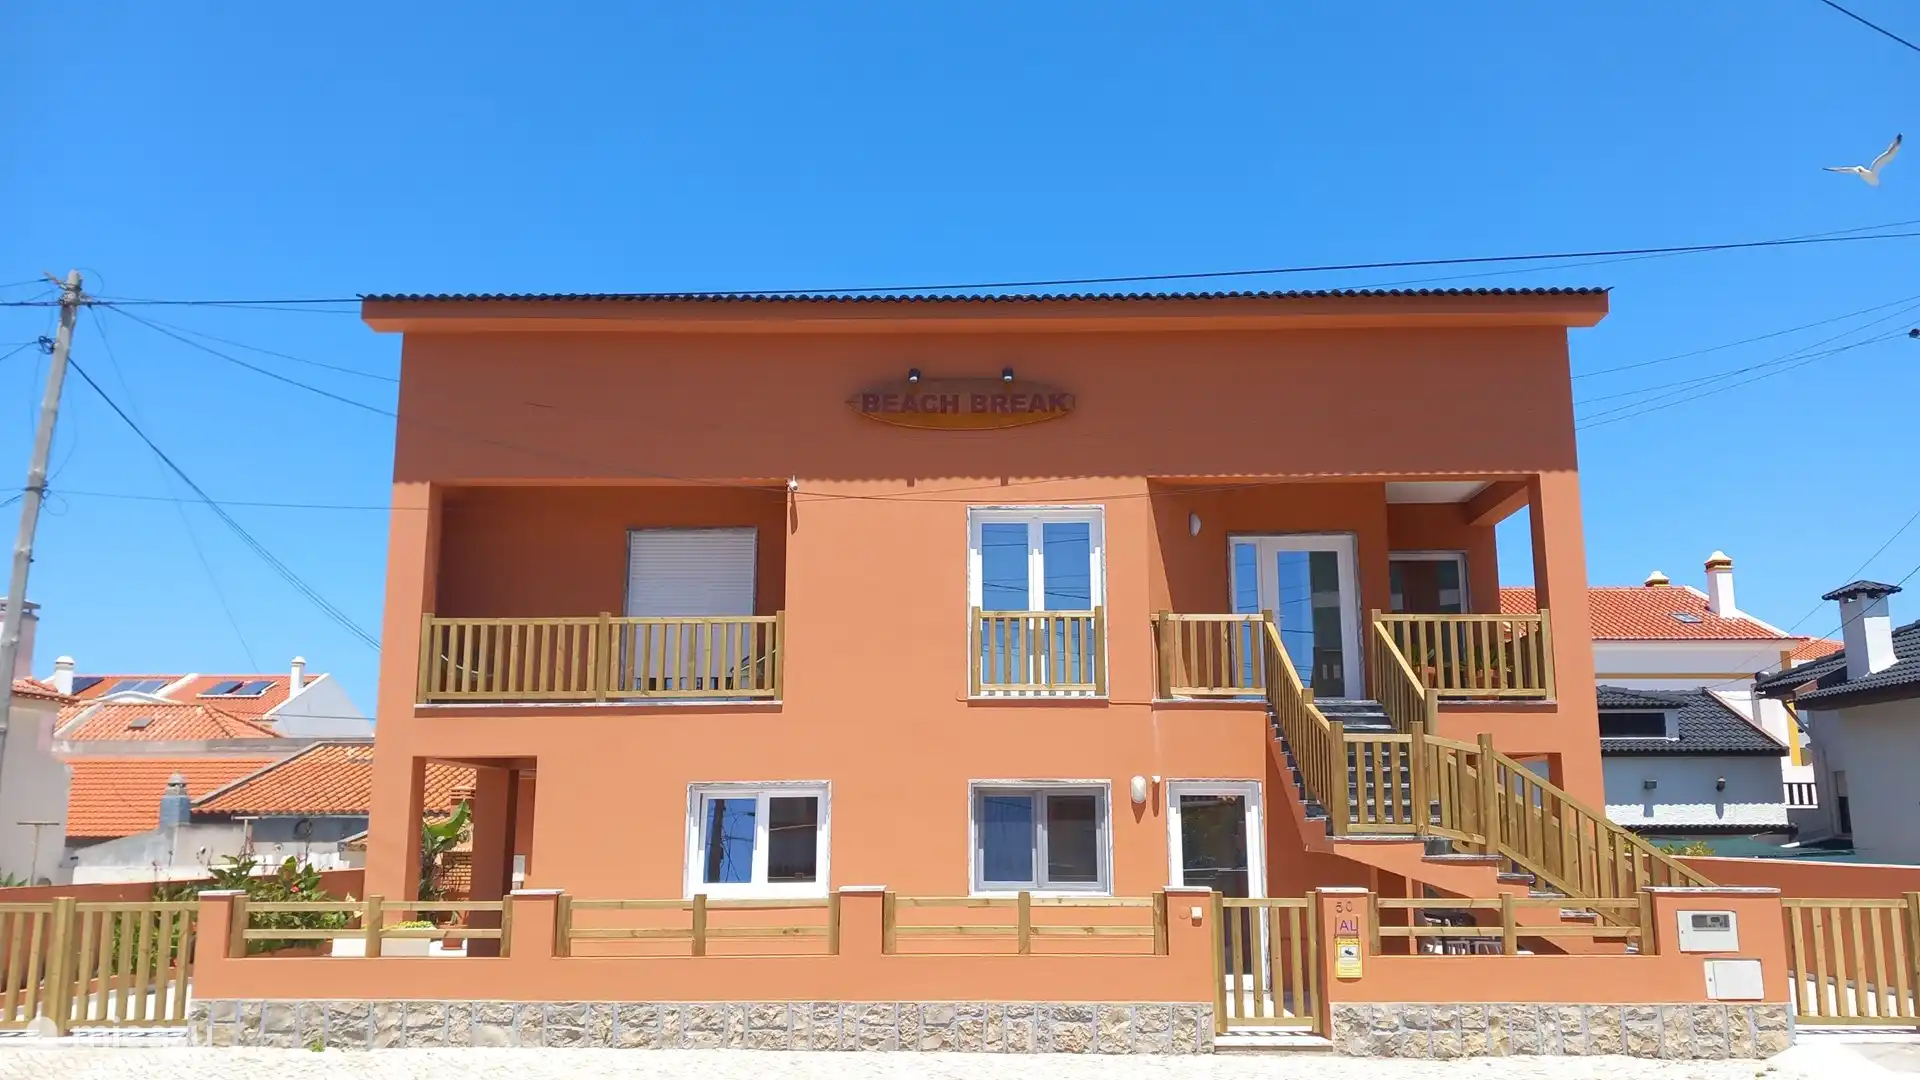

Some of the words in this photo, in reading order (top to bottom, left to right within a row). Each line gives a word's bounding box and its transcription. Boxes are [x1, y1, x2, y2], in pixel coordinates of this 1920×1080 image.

[861, 393, 960, 414] BEACH
[970, 393, 1075, 414] BREAK
[1340, 919, 1358, 932] AL
